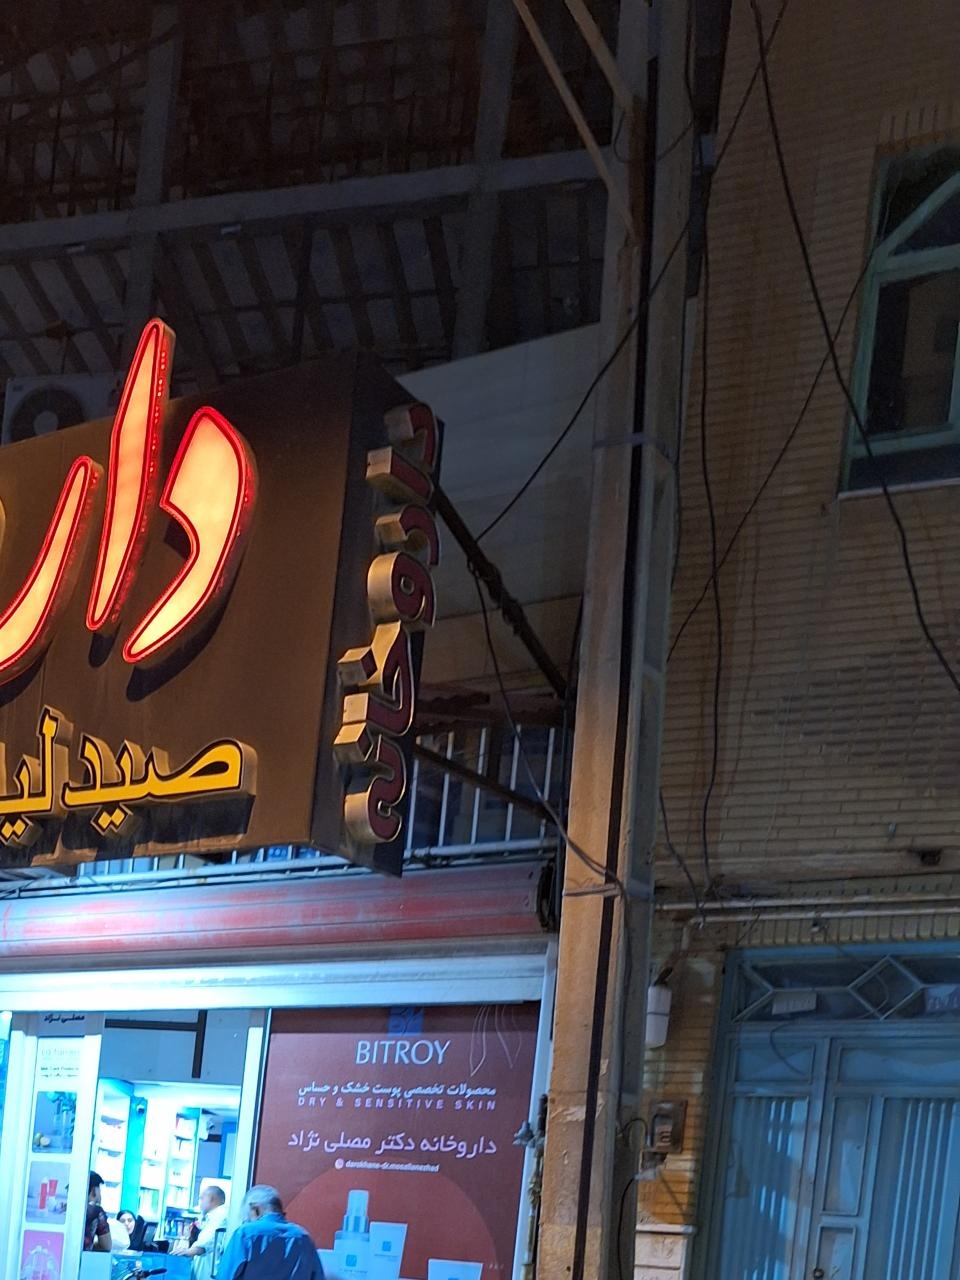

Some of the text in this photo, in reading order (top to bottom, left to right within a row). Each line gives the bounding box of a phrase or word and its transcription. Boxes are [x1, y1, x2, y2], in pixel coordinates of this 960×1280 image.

[355, 1039, 451, 1065] BITROY
[298, 1080, 330, 1096] حساس
[340, 1080, 370, 1095] خشک
[371, 1082, 403, 1099] پوست
[403, 1082, 445, 1099] تخصصی
[446, 1083, 497, 1099] محصولات
[297, 1096, 497, 1111] DRY & SENSITIVE SKIN
[287, 1128, 498, 1159] داروخانه دکتر مصلی نژاد
